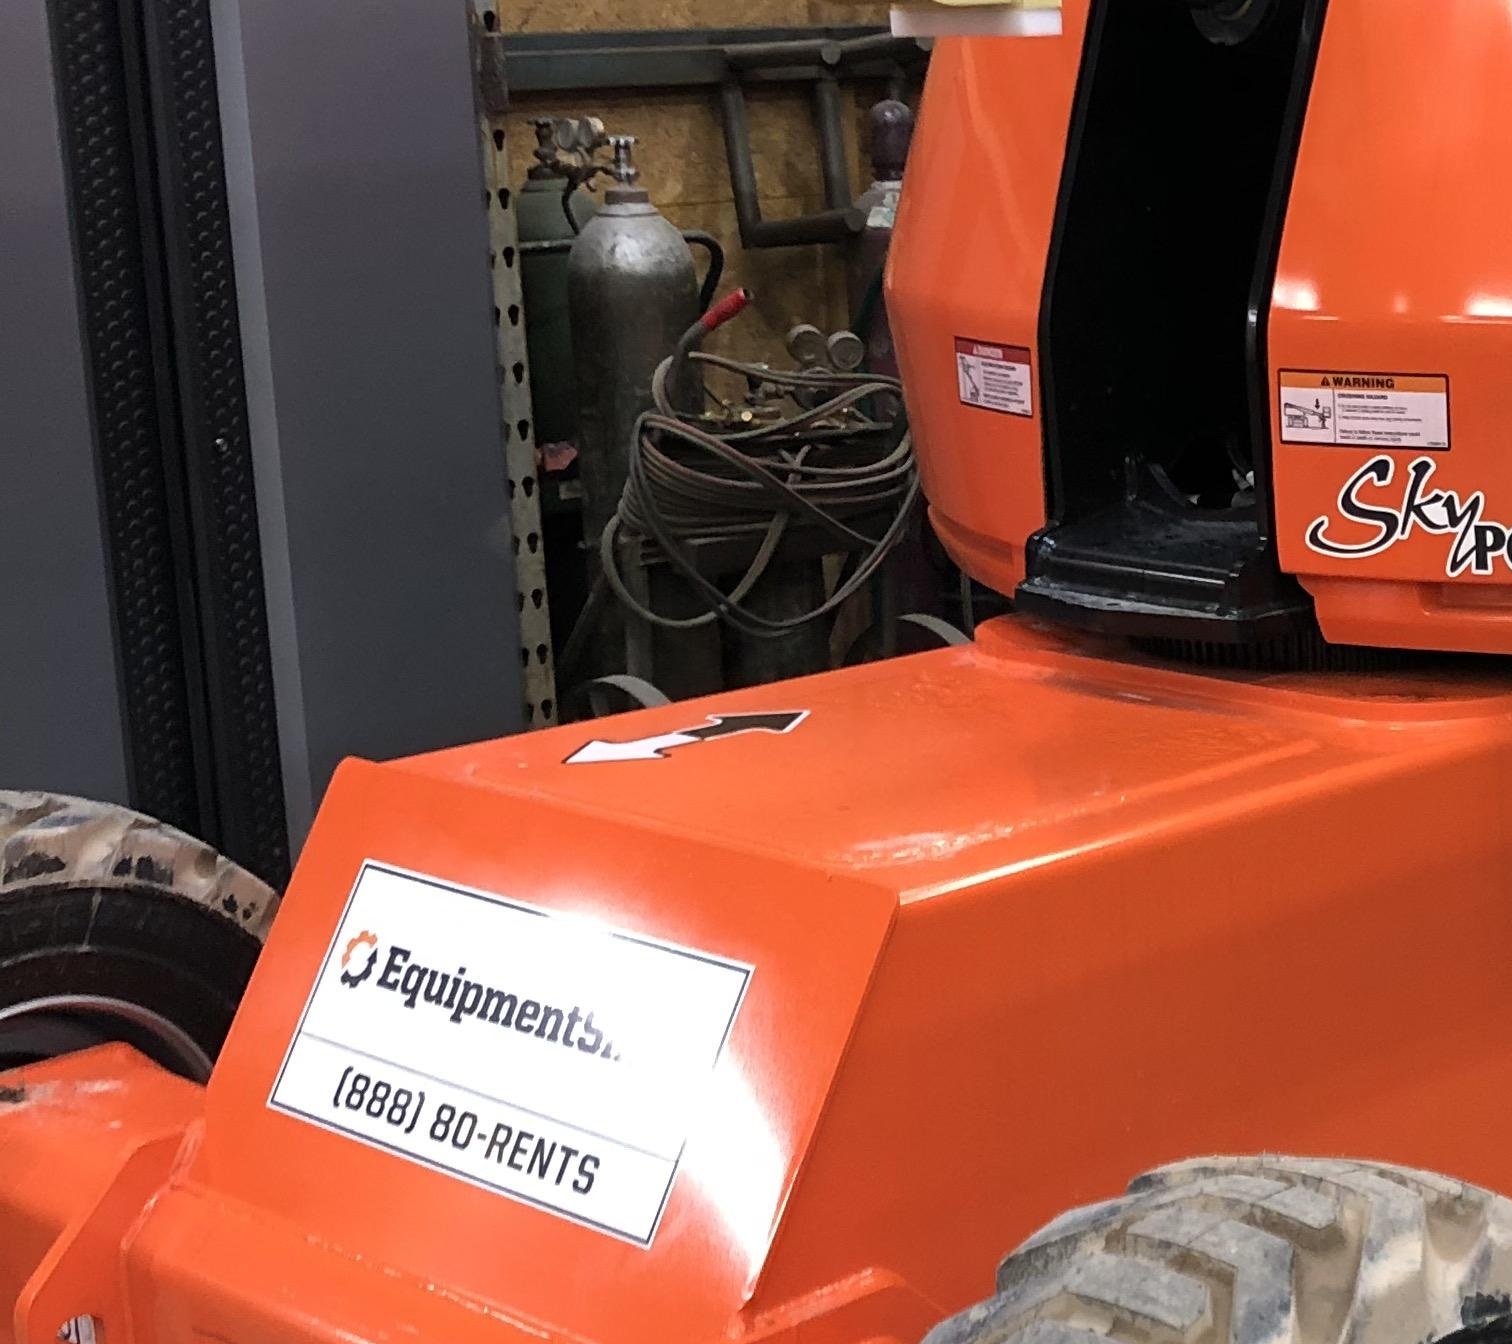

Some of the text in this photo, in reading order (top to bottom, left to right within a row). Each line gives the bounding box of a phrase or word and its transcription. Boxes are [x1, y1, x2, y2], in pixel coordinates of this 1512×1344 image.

[1332, 376, 1395, 389] WARNING
[331, 1065, 601, 1196] (888) 80-RENTS
